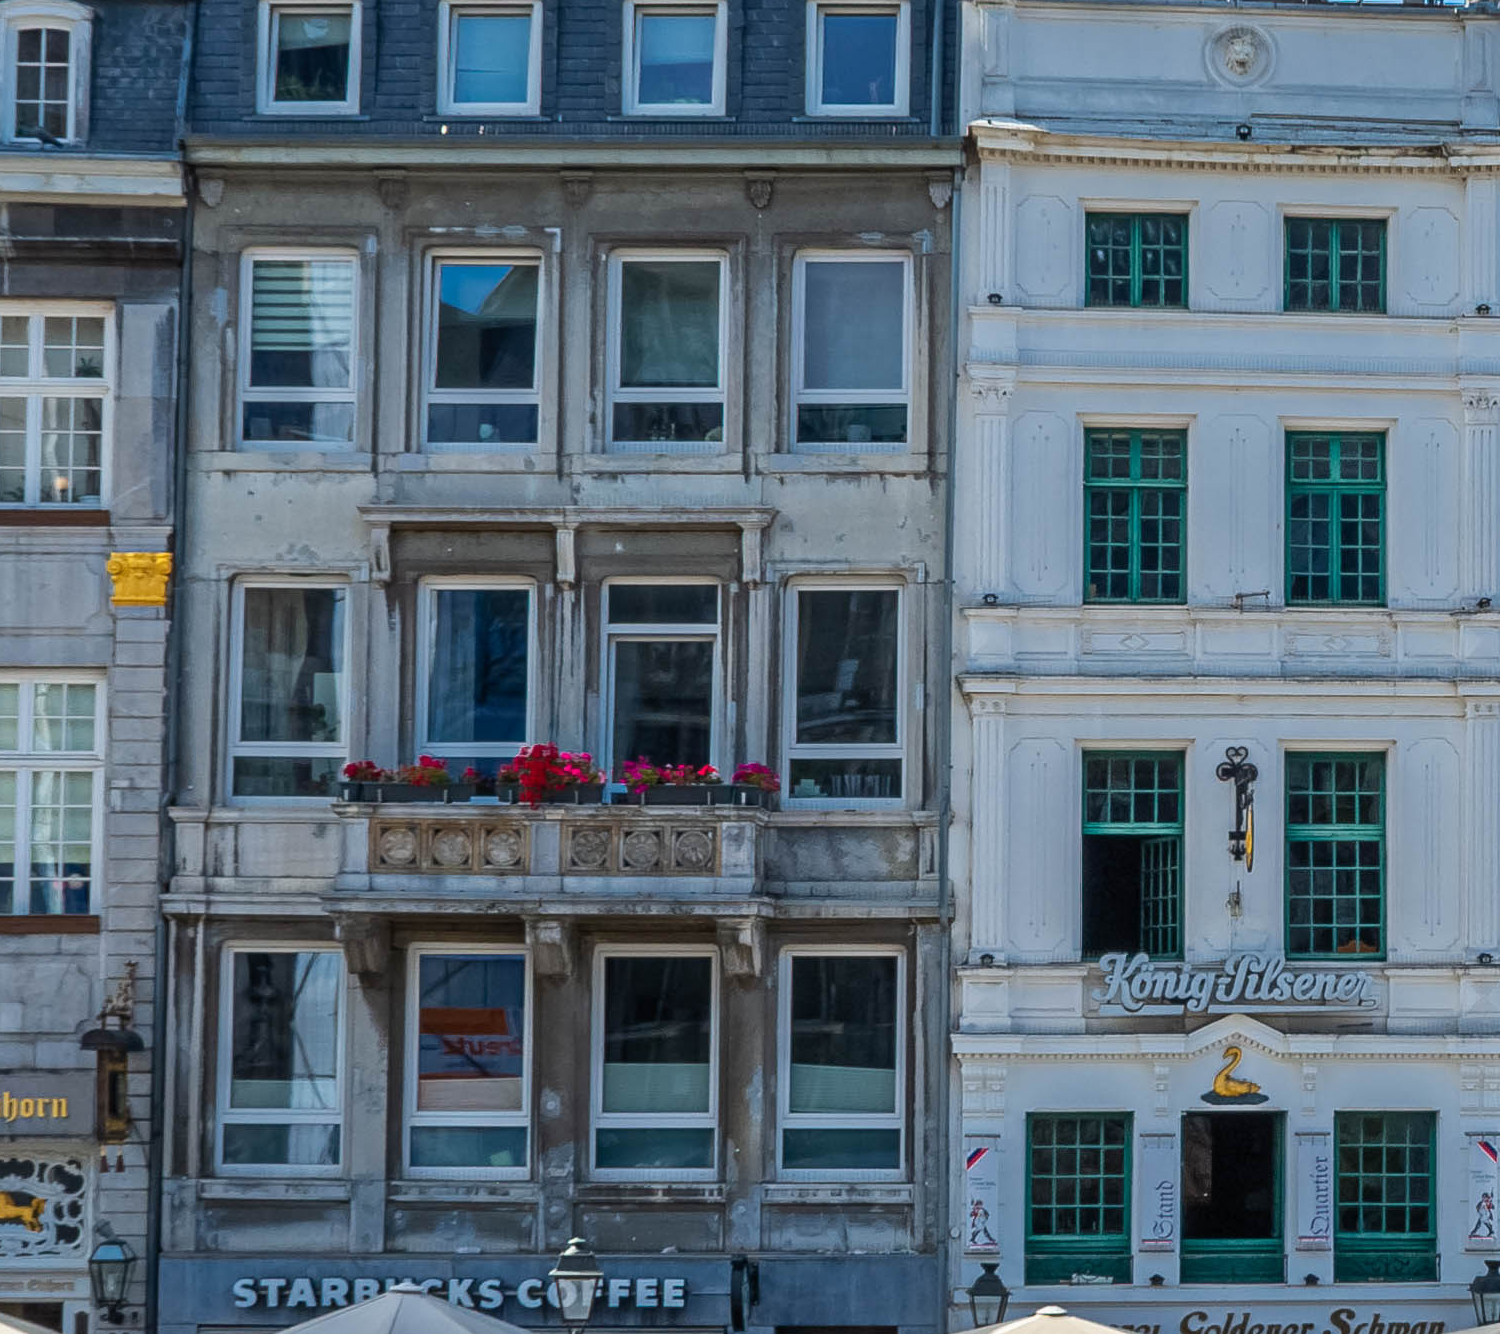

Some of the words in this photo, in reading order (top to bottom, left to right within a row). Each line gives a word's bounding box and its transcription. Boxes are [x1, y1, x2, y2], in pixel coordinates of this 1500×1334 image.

[1092, 952, 1378, 1013] König-Pilsener
[1152, 1180, 1175, 1240] Stand
[1310, 1155, 1330, 1235] Quartier
[232, 1277, 503, 1309] STARBCKS
[516, 1277, 686, 1309] COFFEE
